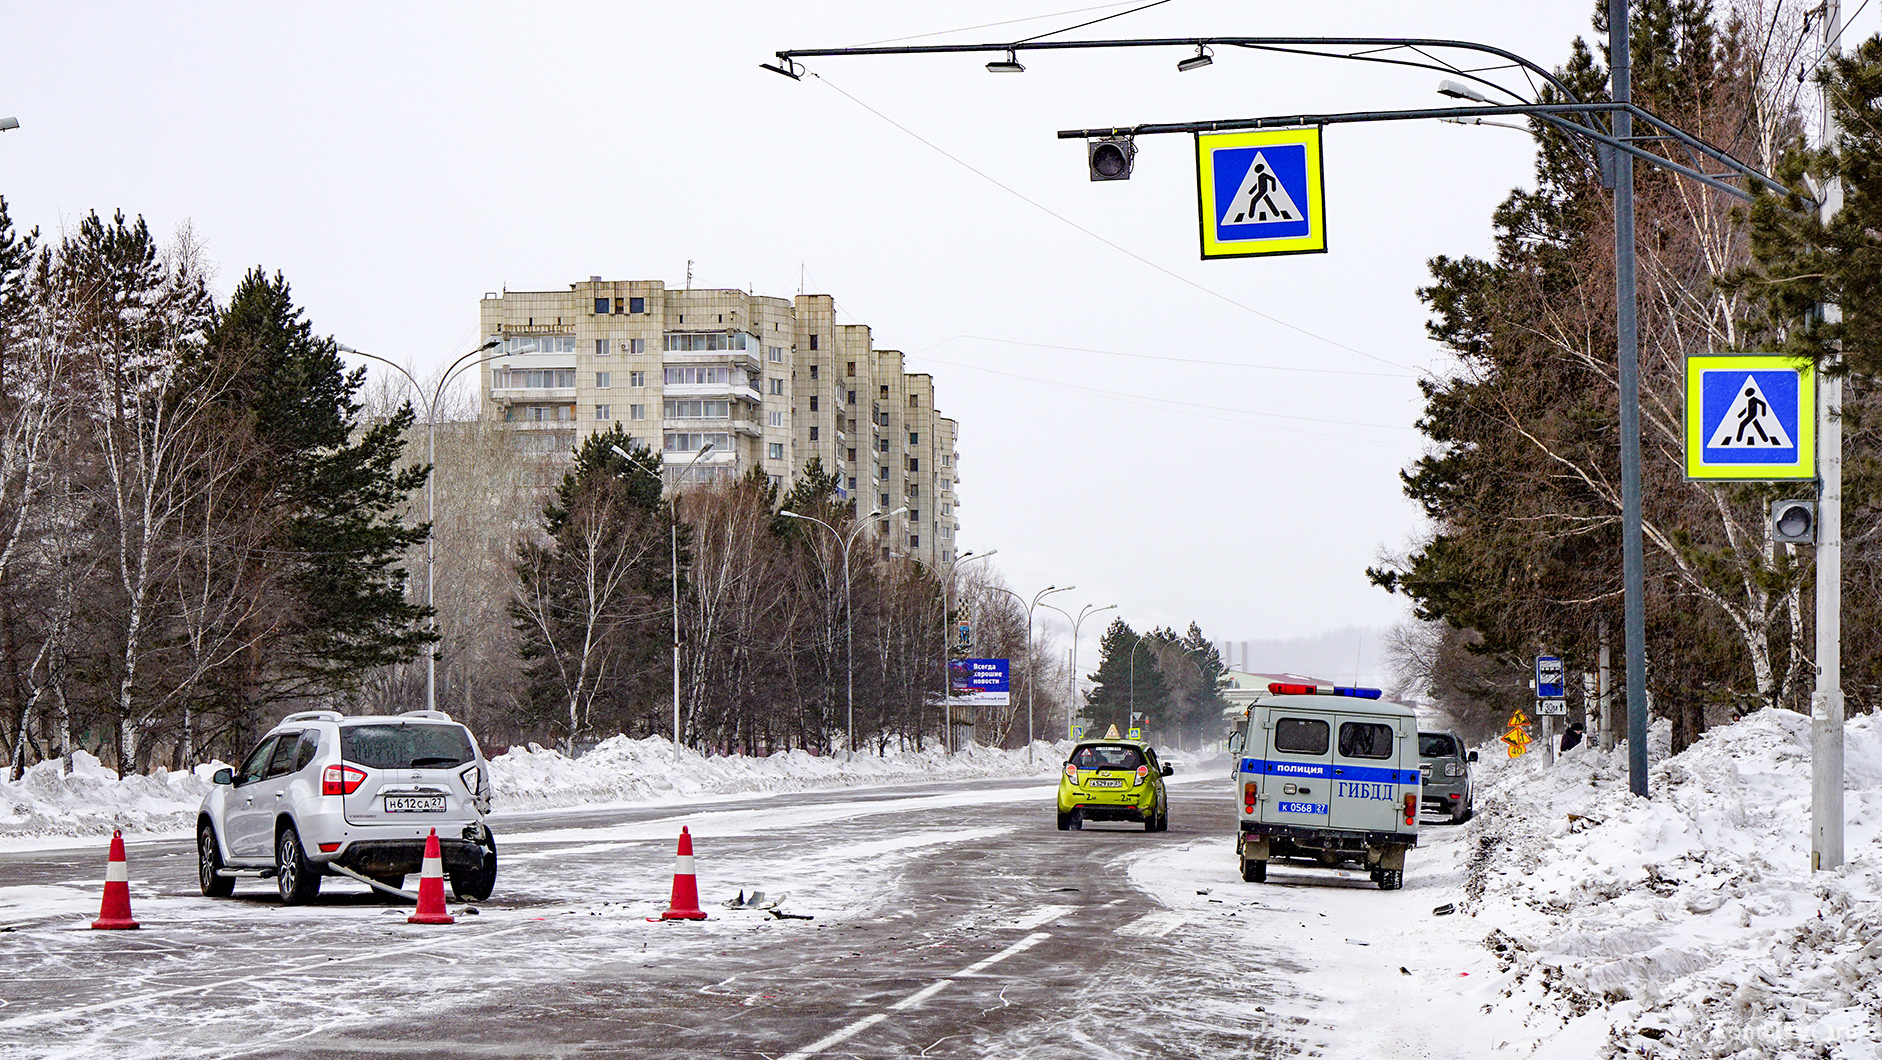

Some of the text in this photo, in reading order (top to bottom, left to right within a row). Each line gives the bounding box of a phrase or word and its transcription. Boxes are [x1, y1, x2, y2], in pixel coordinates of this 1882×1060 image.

[973, 663, 997, 671] Всегда
[973, 671, 1003, 679] хорошие
[1511, 747, 1523, 755] 40
[1338, 781, 1394, 801] ГИБДД
[1290, 803, 1312, 813] 0568
